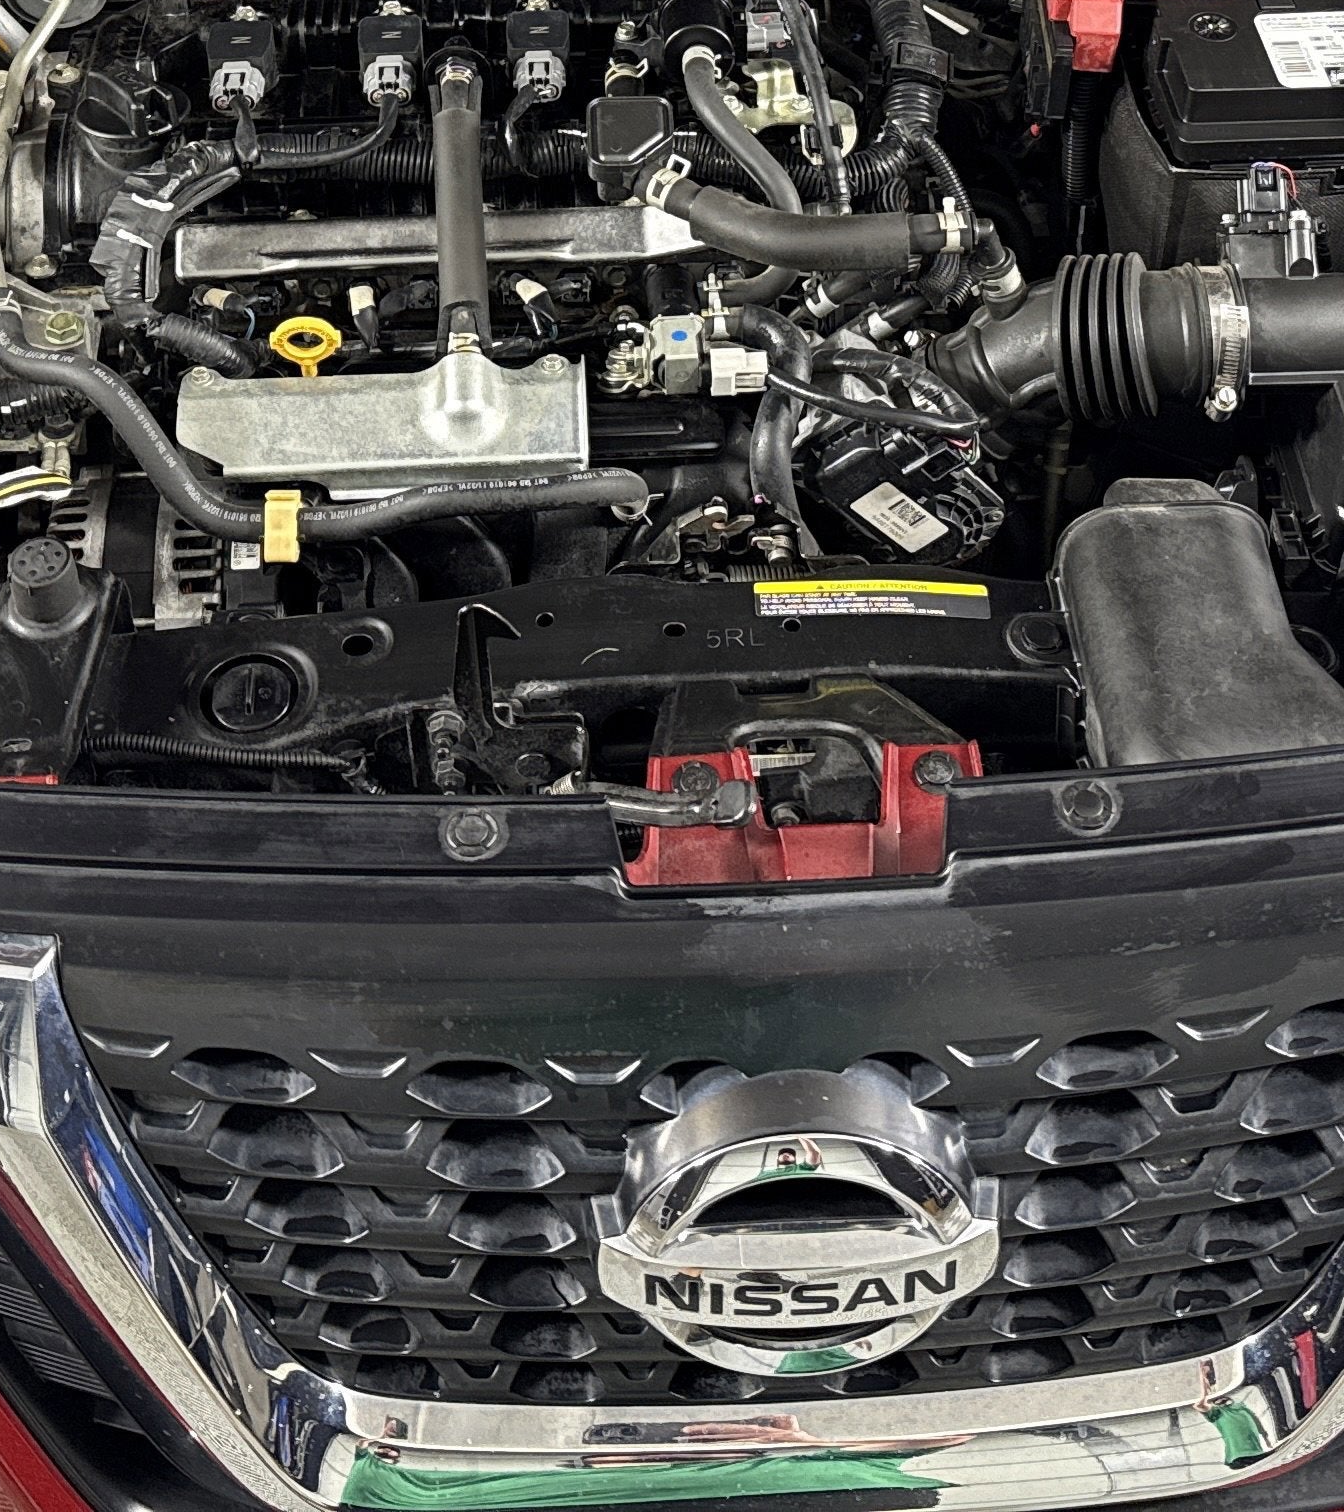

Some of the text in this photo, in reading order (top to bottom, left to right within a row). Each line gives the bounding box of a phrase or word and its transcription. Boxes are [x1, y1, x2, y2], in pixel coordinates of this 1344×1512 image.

[880, 583, 928, 591] ATTENTION
[706, 627, 766, 649] 5RL
[645, 1258, 958, 1317] NISSAN
